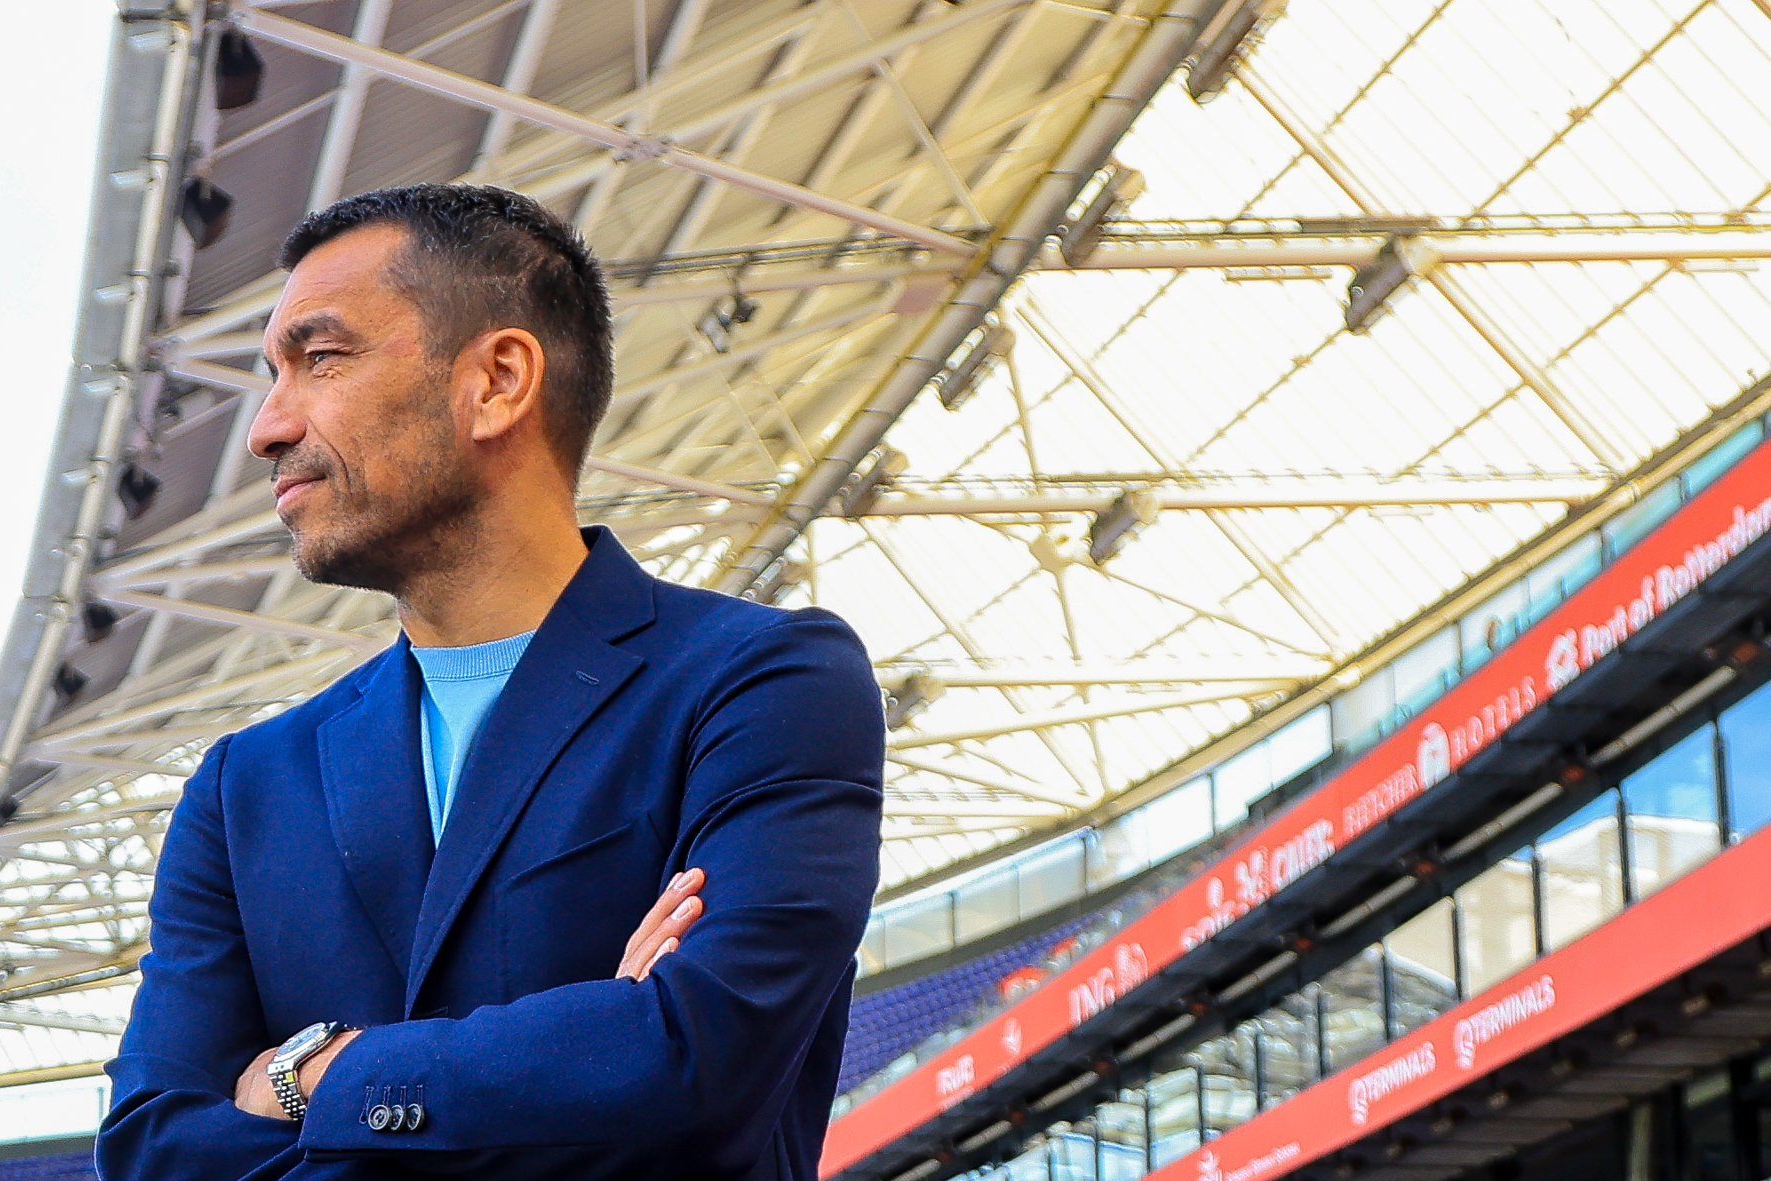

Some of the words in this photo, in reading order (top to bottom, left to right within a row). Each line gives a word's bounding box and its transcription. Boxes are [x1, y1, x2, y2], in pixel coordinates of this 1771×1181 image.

[1581, 604, 1628, 671] Port
[1451, 676, 1537, 762] HOTELS
[1468, 975, 1556, 1046] TERMINALS
[1365, 1041, 1436, 1101] TERMINALS
